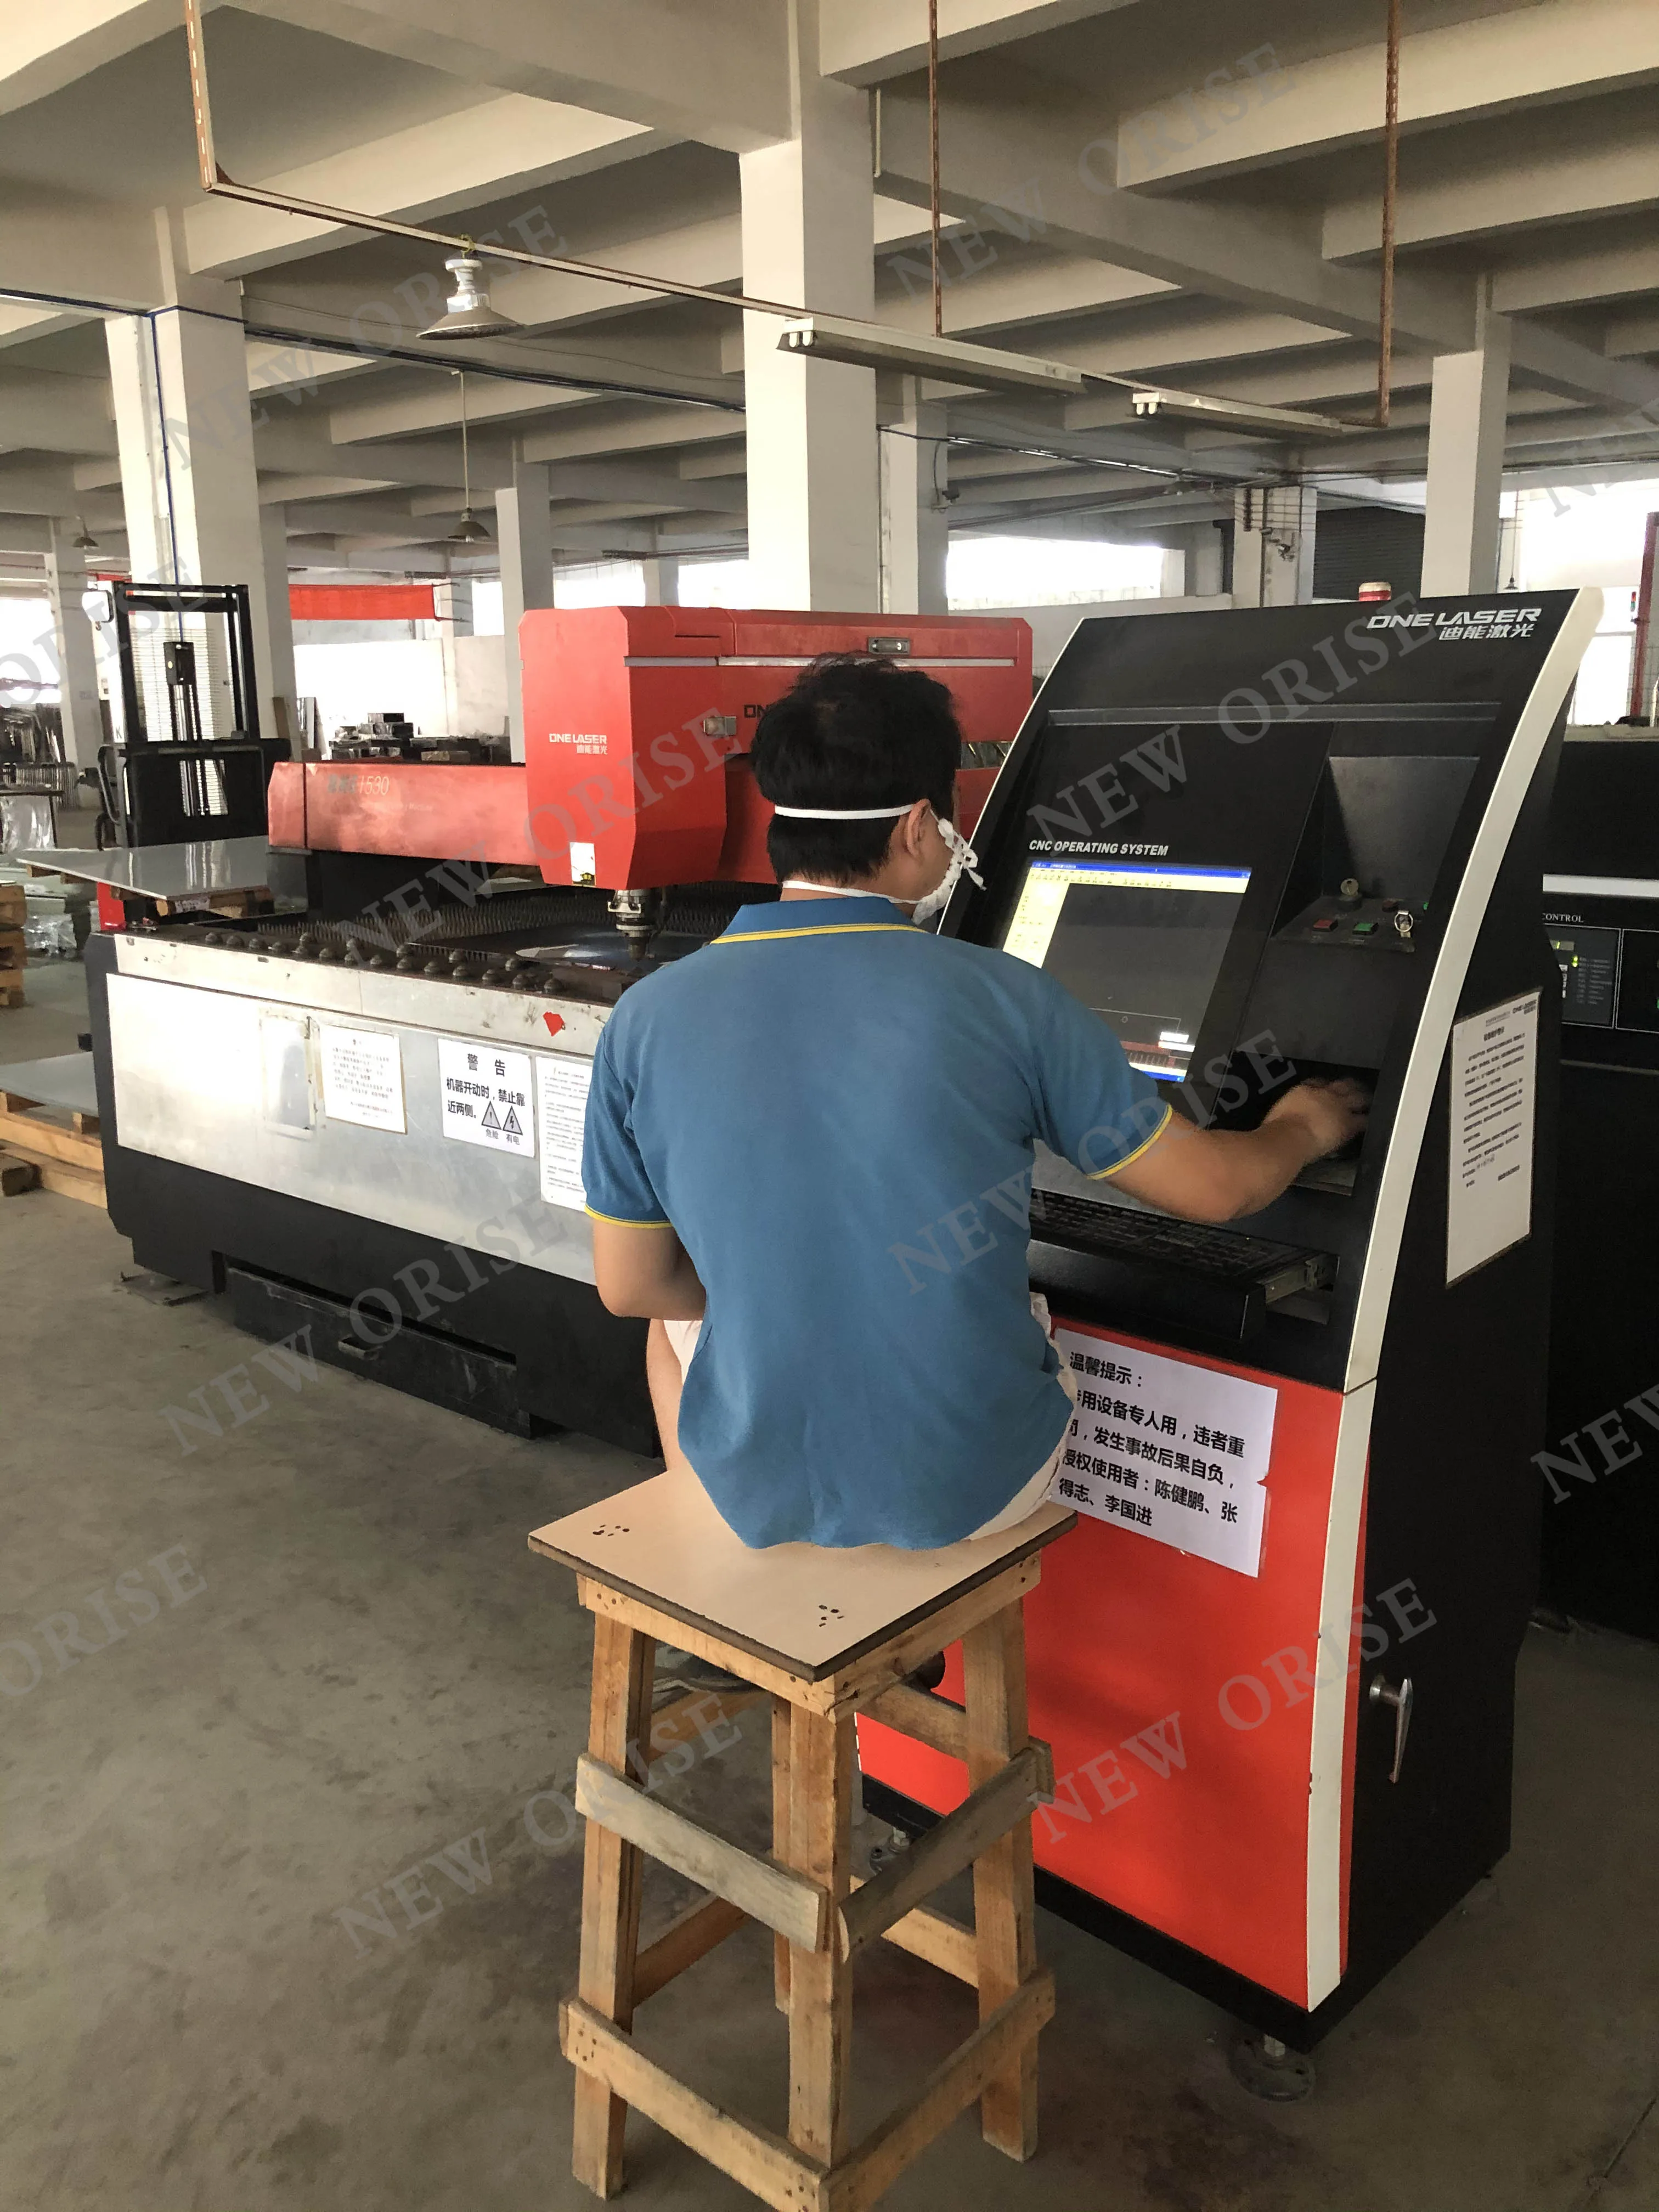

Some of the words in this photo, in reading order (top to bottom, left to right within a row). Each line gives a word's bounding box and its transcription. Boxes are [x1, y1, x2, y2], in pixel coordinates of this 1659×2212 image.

[1367, 613, 1435, 629] ONE
[1435, 608, 1542, 626] LASER
[1439, 623, 1534, 641] 迪能激光
[549, 733, 572, 743] ONE
[572, 733, 607, 744] LASER
[1029, 840, 1052, 851] CNC
[1053, 840, 1119, 854] OPERATING
[1120, 843, 1170, 856] SYSTEM
[447, 1077, 526, 1107] 机器开动时，禁止靠
[447, 1099, 477, 1119] 近两侧。
[486, 1128, 499, 1140] 危险
[506, 1133, 520, 1146] 有电
[1069, 1351, 1143, 1387] 温馨提示：
[1059, 1478, 1153, 1527] 得志、李国进
